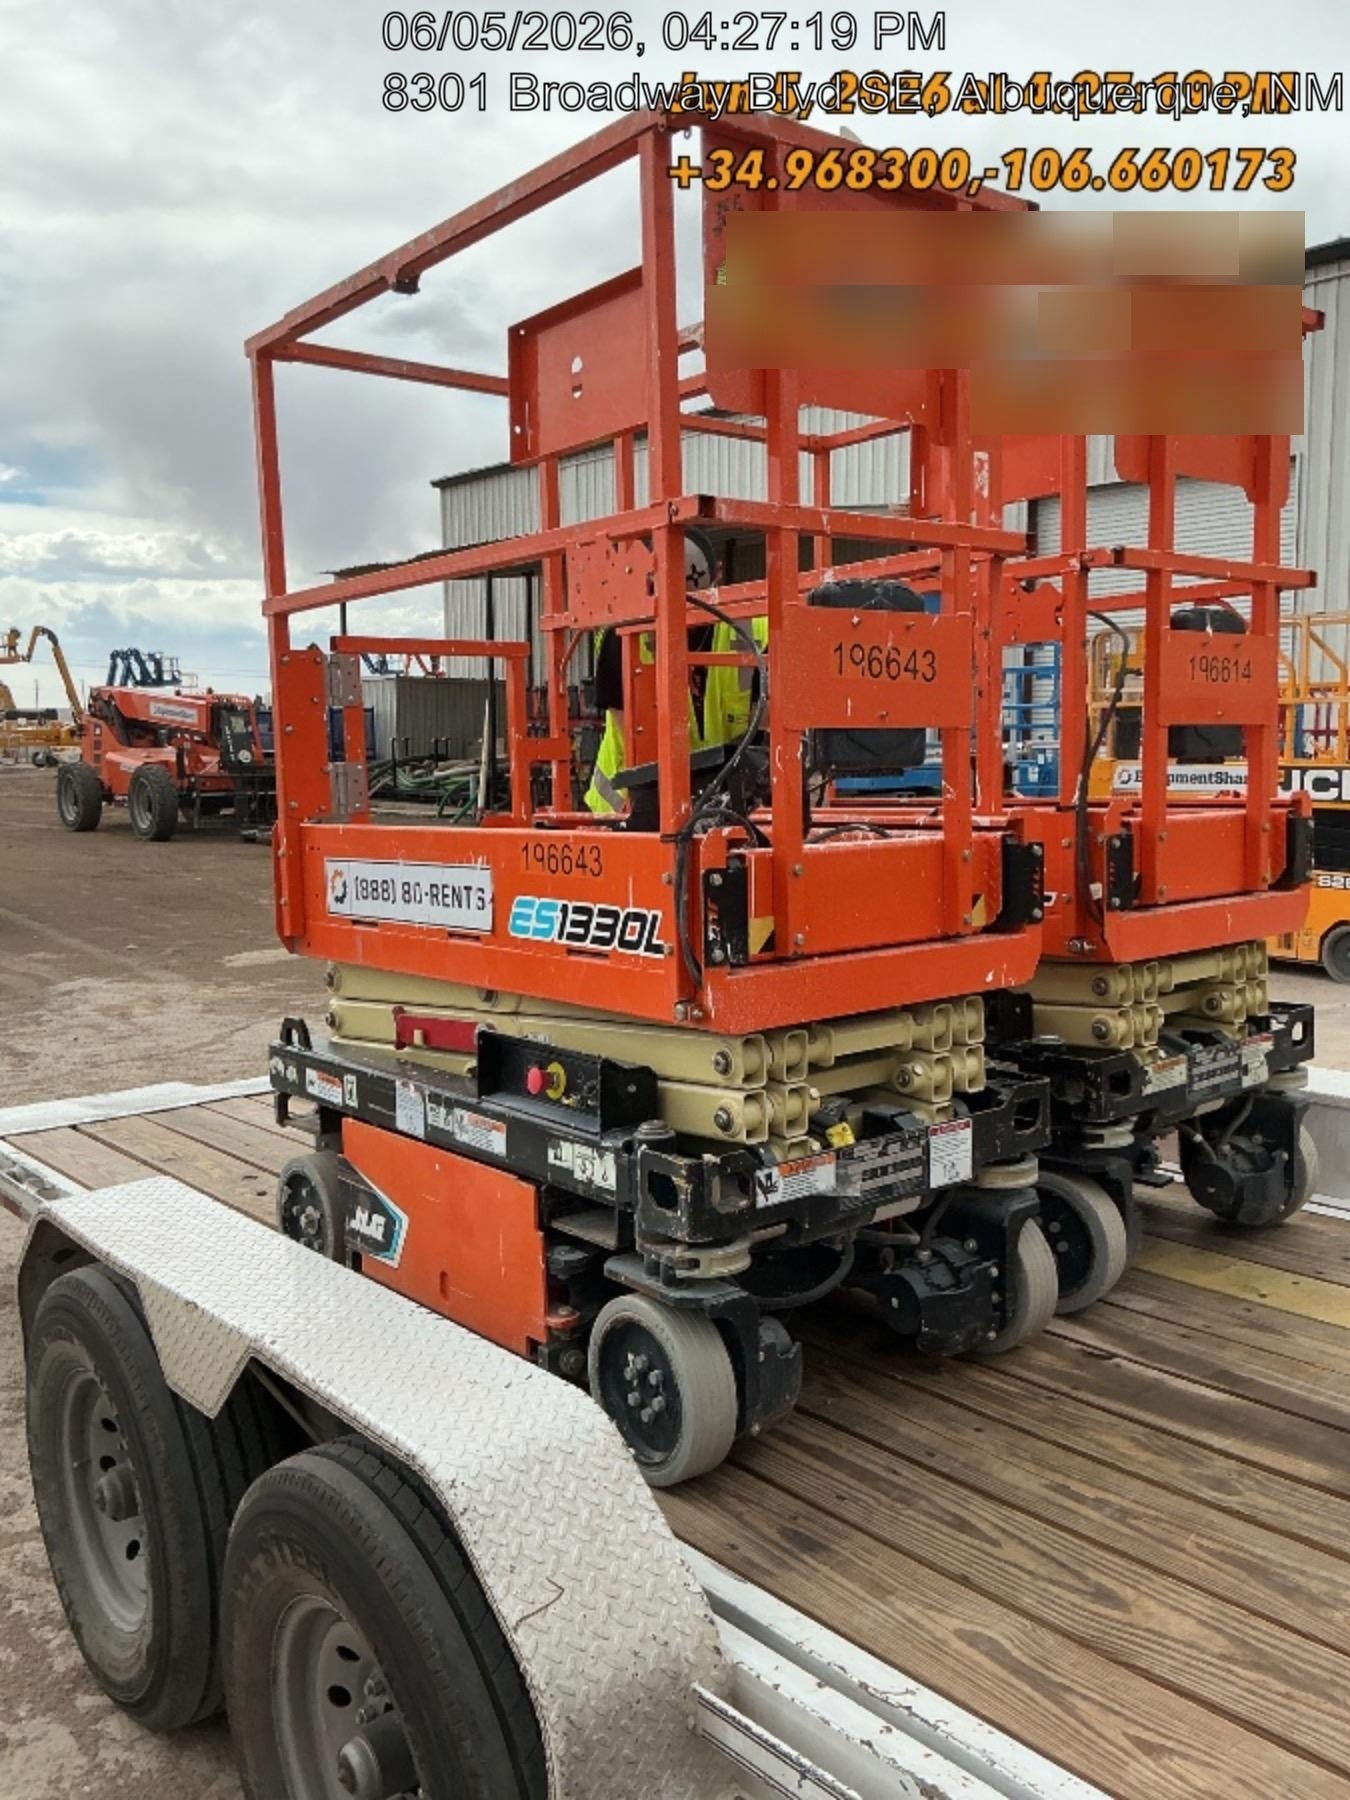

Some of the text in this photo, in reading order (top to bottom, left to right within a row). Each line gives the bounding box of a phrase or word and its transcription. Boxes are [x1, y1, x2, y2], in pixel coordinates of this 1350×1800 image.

[834, 641, 937, 683] 196643
[1189, 656, 1252, 683] 196614
[520, 842, 603, 877] 196643
[355, 874, 397, 903] (888)
[509, 897, 666, 957] ES1330L
[349, 1205, 386, 1242] JLG
